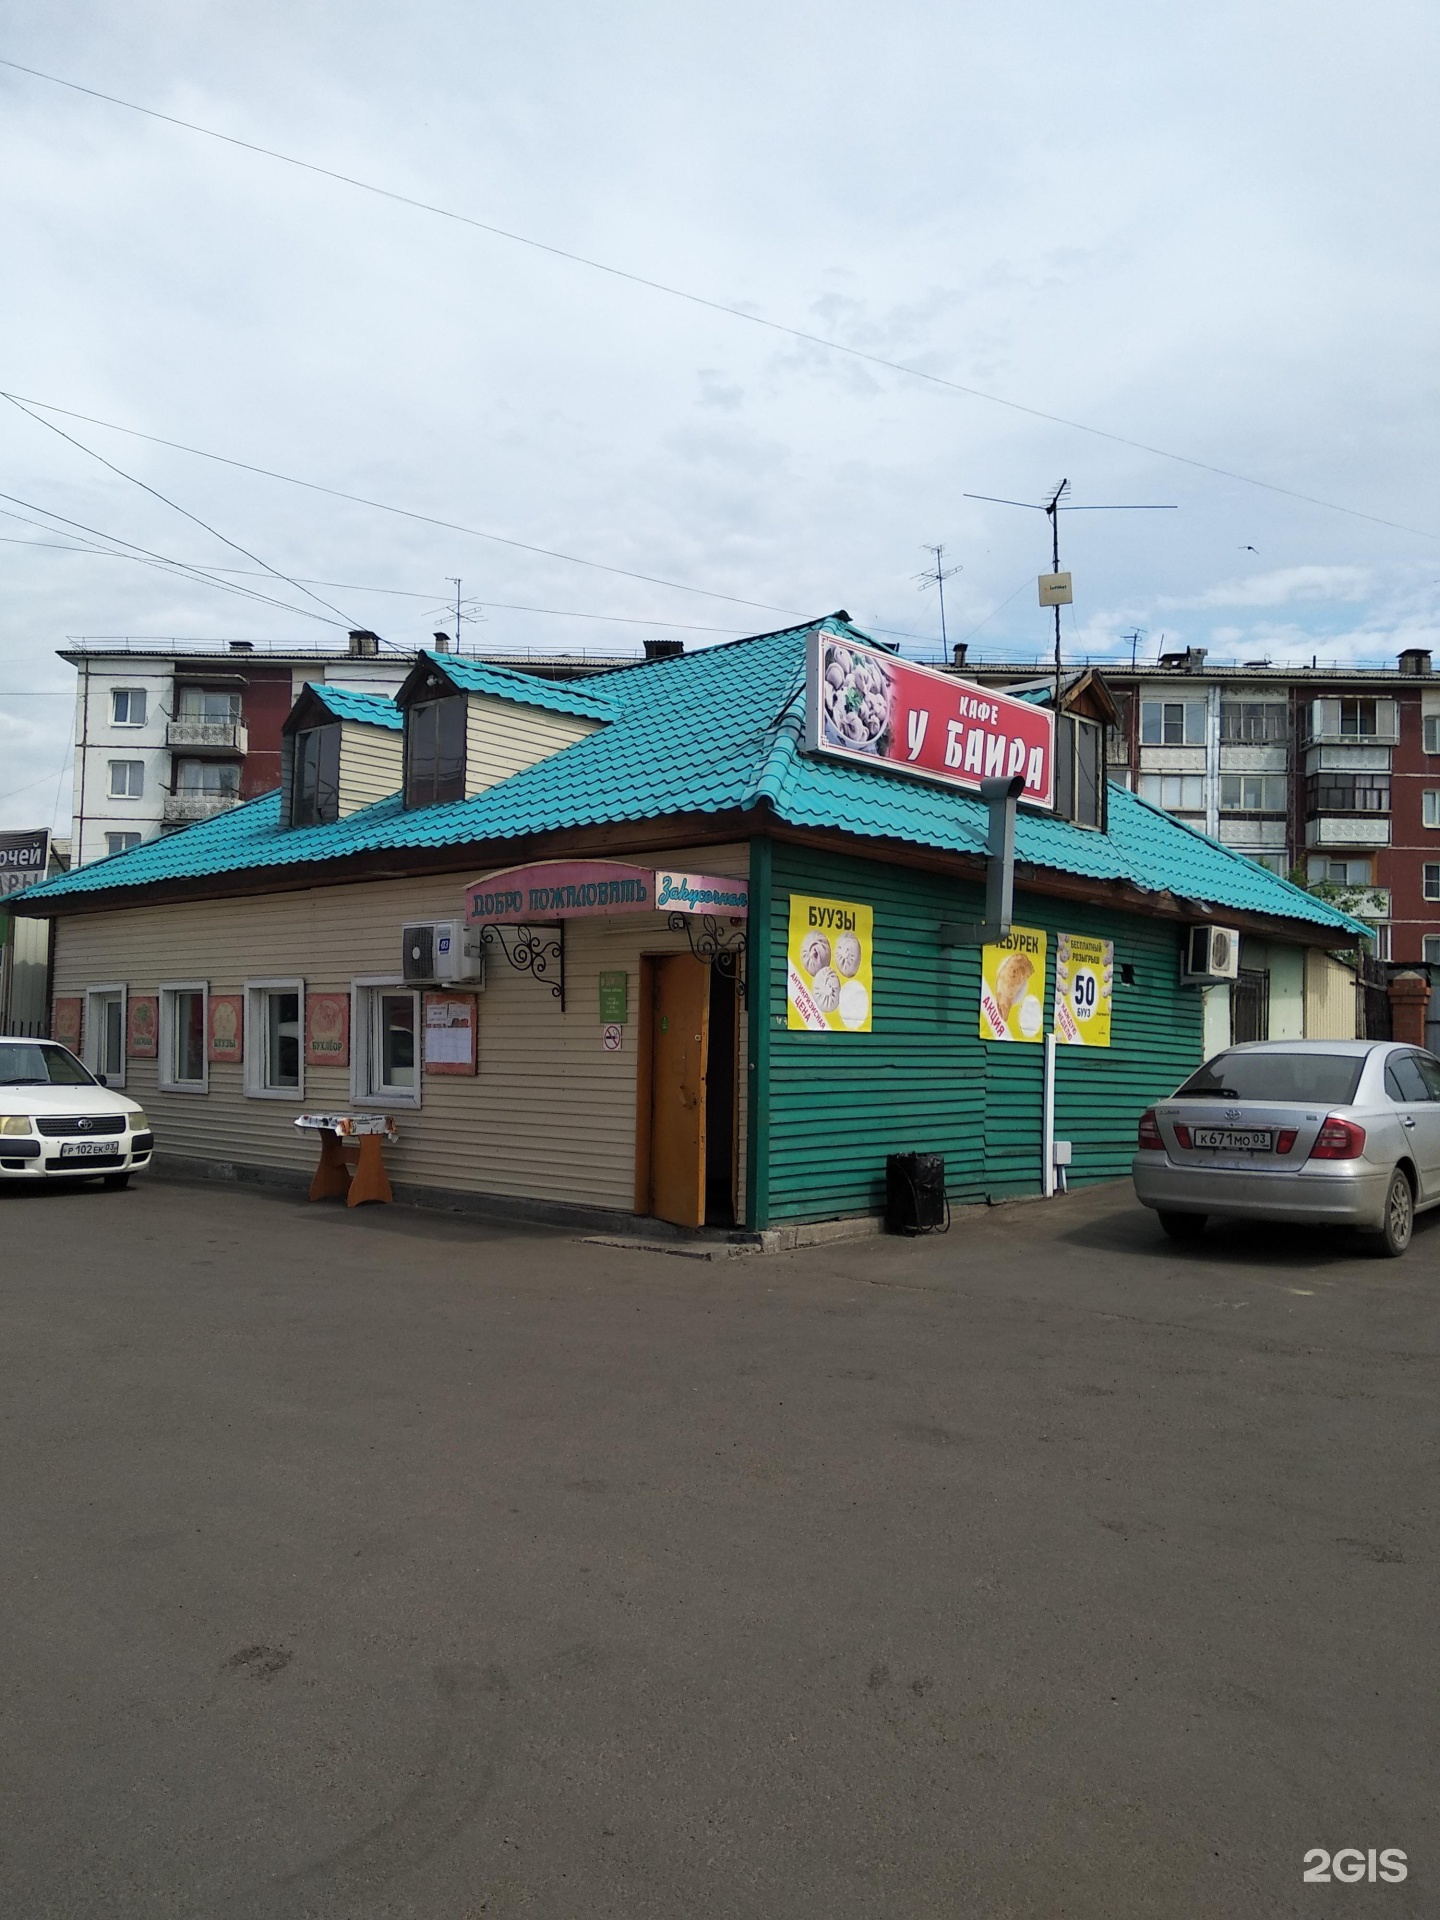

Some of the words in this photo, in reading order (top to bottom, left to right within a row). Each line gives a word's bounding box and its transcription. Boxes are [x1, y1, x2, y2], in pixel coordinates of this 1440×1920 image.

[959, 695, 999, 726] КАФЕ
[907, 709, 930, 762] У
[944, 718, 1044, 792] БАИРА
[0, 873, 39, 897] РЫ
[471, 890, 523, 918] ДОБРО
[529, 878, 648, 911] ПОЖАЛОВАТЬ
[657, 875, 748, 910] Закусочная
[808, 905, 856, 932] БУУЗЫ
[1070, 939, 1103, 953] БЕСПЛАТНЫЙ
[1072, 952, 1101, 965] РОЗЫГРЫШ
[790, 972, 826, 1030] АНТИКРИЗИСНАЯ
[1075, 974, 1096, 1007] 50
[794, 995, 811, 1023] ЦЕНА
[982, 996, 1005, 1038] АКЦИЯ
[1060, 1003, 1077, 1036] КАЖДУЮ
[1077, 1007, 1091, 1018] БУУЗ
[1058, 1011, 1073, 1042] НЕДЕЛЮ
[213, 1038, 236, 1048] БУУЗЫ
